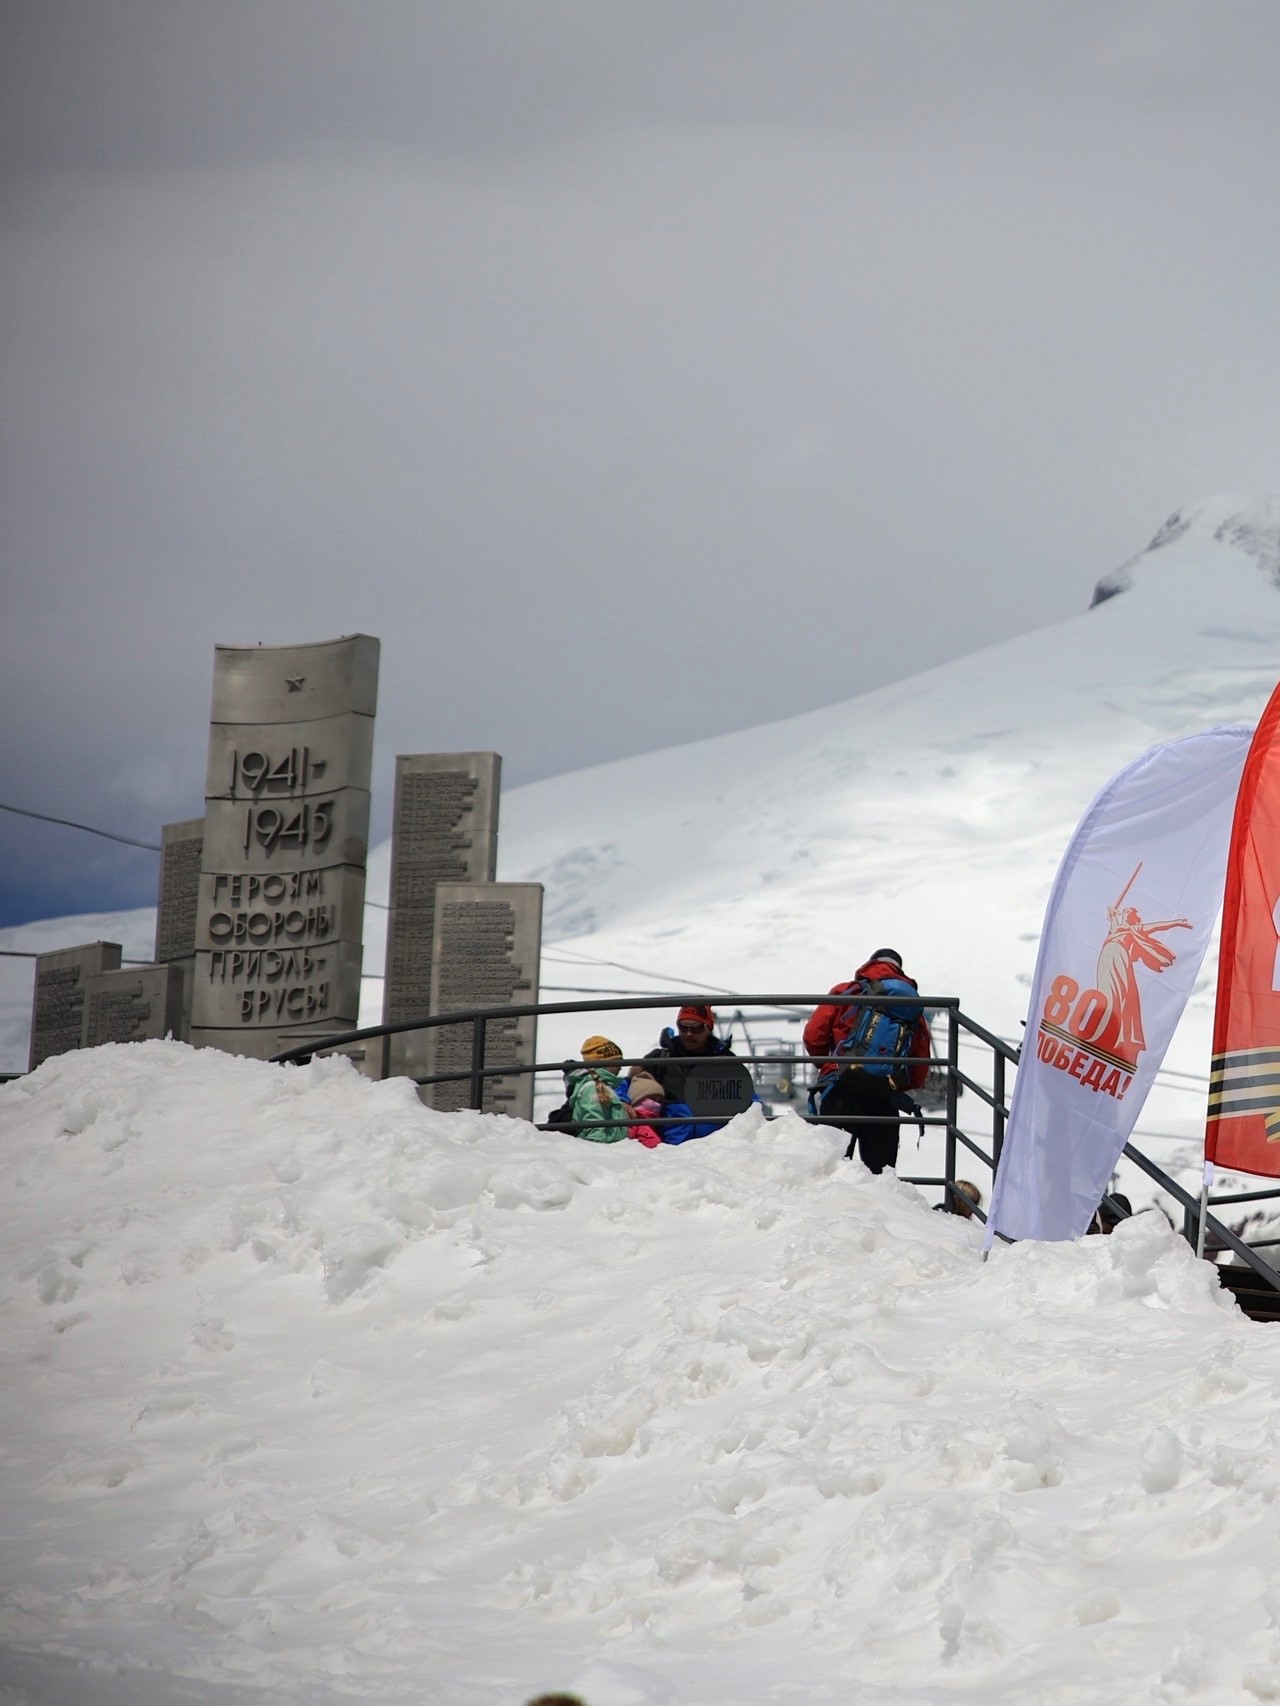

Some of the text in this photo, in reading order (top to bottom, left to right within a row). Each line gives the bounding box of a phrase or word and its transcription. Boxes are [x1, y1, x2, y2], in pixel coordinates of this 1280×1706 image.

[229, 746, 327, 790] 1941-
[243, 799, 335, 849] 1945
[213, 870, 324, 900] ГЕРОЯМ
[208, 904, 336, 938] ОБОРОНЫ
[209, 948, 326, 979] ПРИЭЛЬ-
[240, 982, 330, 1016] БРУСЬЯ
[1044, 974, 1112, 1042] 80
[1036, 1030, 1133, 1101] ПОБЕДА!
